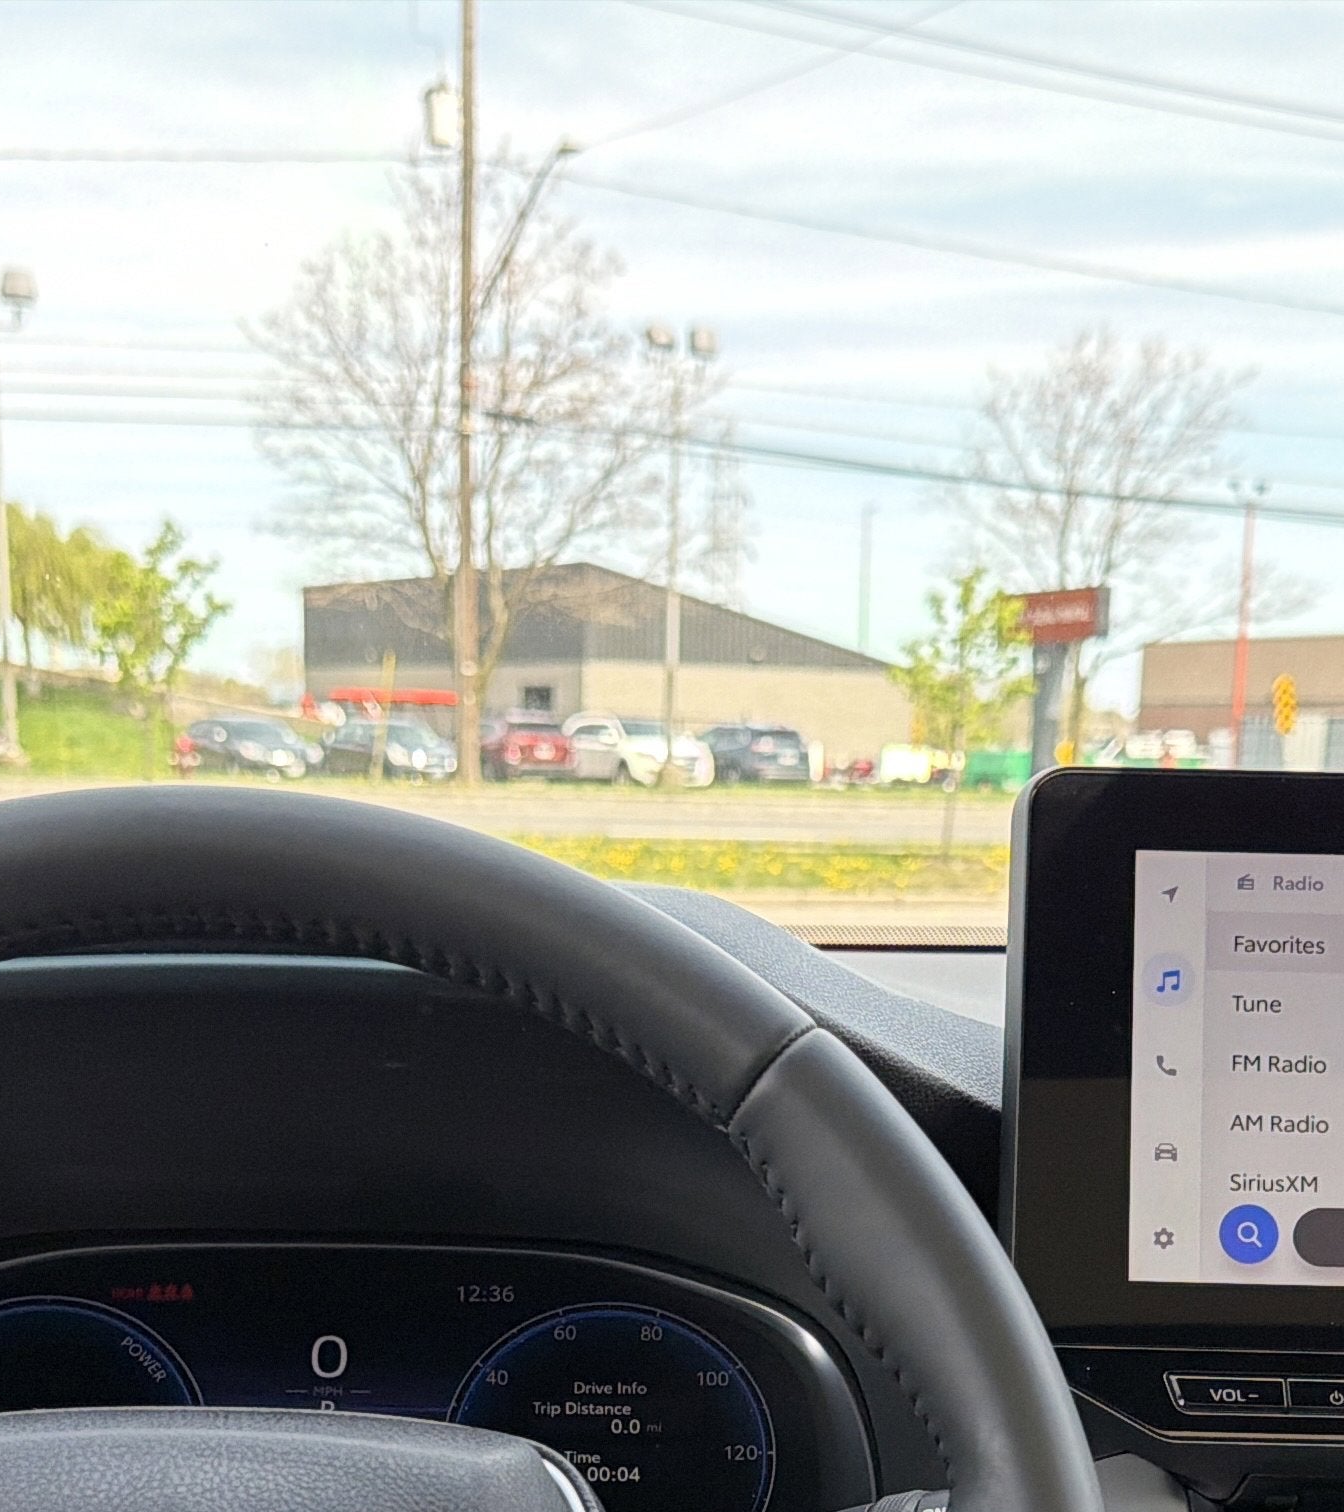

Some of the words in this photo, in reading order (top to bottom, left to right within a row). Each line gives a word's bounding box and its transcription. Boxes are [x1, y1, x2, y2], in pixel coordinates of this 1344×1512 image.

[1272, 875, 1324, 891] Radio
[1234, 935, 1325, 955] Favorites
[1231, 995, 1282, 1013] Tune
[1232, 1055, 1261, 1072] FM
[1268, 1055, 1327, 1074] Radio
[1230, 1115, 1263, 1131] AM
[1270, 1115, 1329, 1133] Radio
[1229, 1173, 1318, 1192] SiriusXM
[457, 1285, 514, 1302] 12:36
[554, 1325, 576, 1341] 60
[640, 1325, 663, 1341] 80
[120, 1336, 168, 1383] POWER
[486, 1369, 509, 1386] 40
[696, 1371, 729, 1386] 100
[312, 1386, 343, 1397] MPH
[573, 1381, 613, 1395] Drive
[618, 1381, 647, 1395] Info
[533, 1402, 561, 1417] Trip
[565, 1402, 632, 1415] Distance
[611, 1419, 641, 1434] 0.0
[646, 1421, 662, 1434] mi
[564, 1450, 601, 1464] Time
[724, 1445, 757, 1461] 120
[587, 1466, 640, 1482] 00:04
